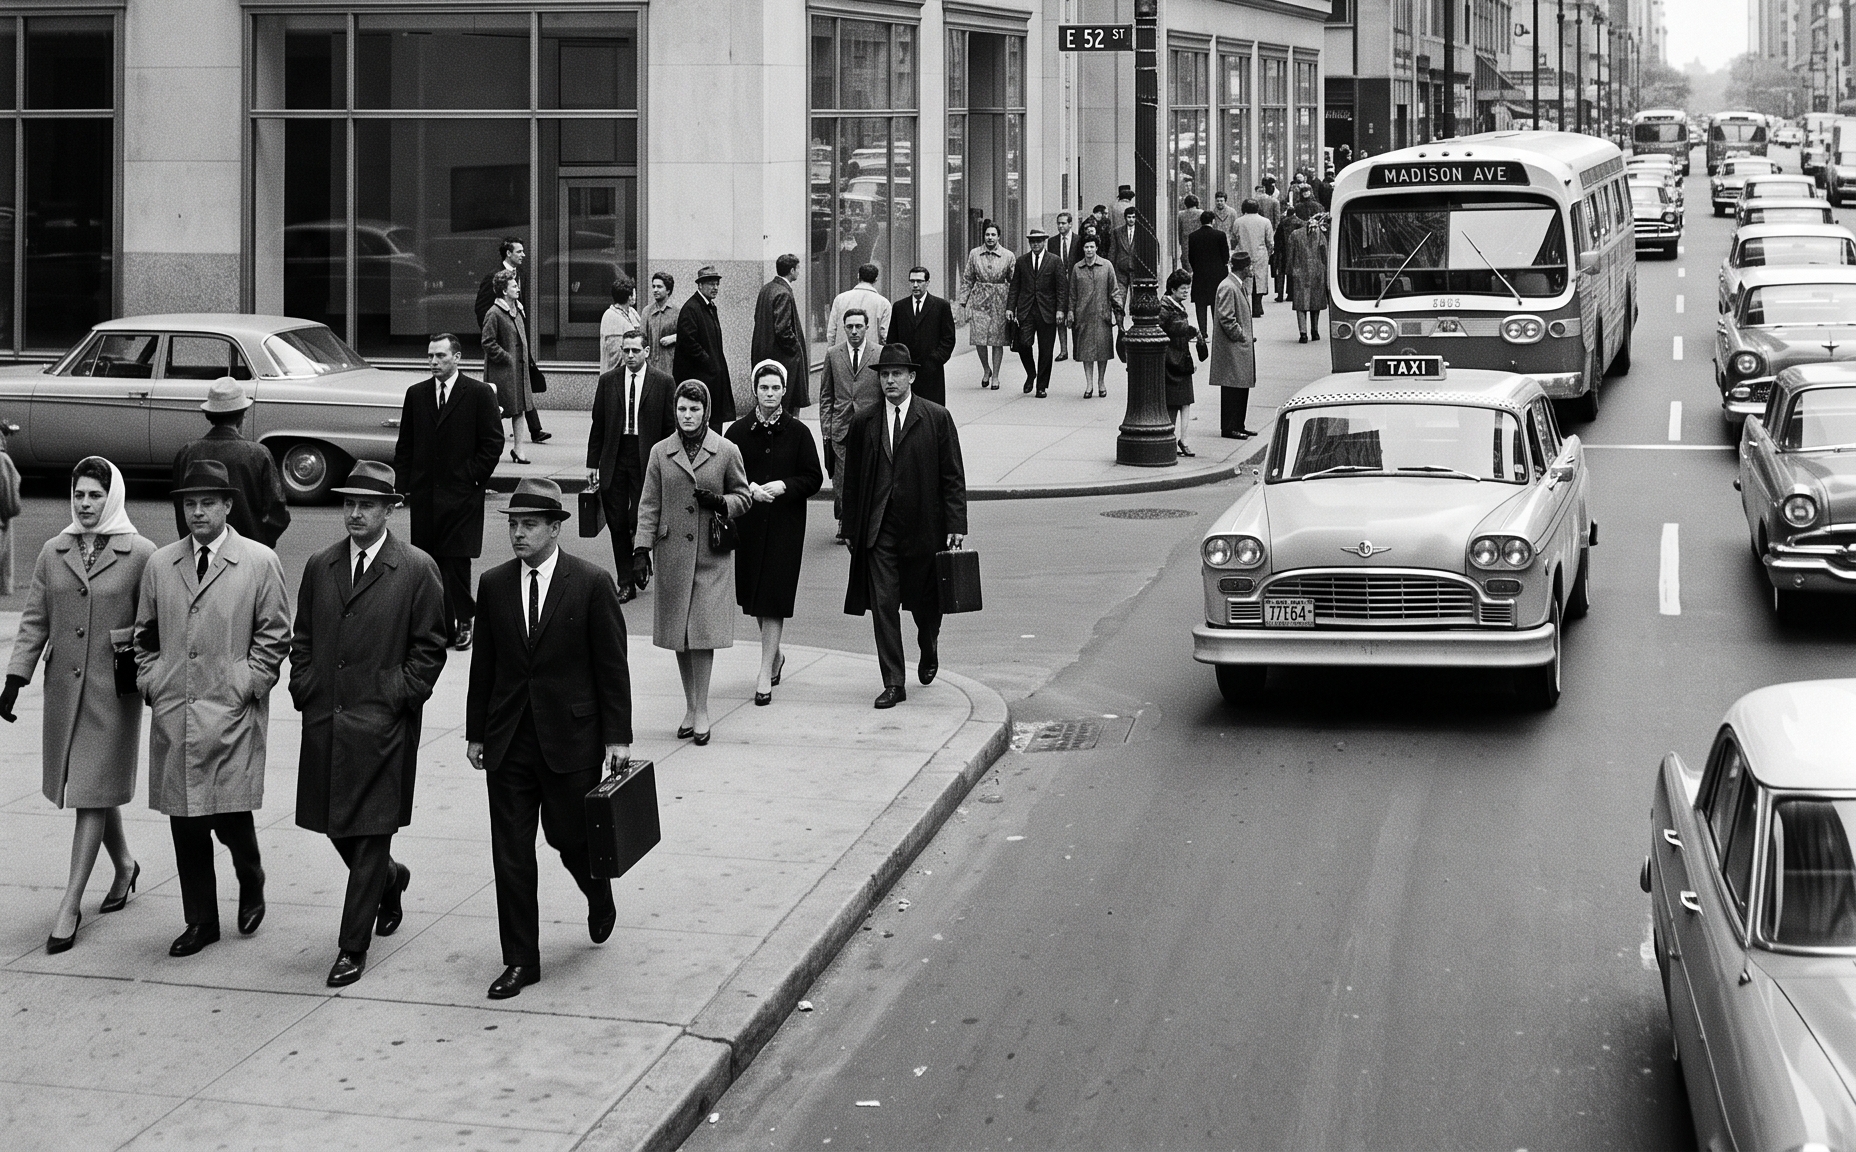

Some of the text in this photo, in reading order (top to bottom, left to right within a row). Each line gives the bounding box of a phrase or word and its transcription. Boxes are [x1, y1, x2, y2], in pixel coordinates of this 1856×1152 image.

[1066, 29, 1125, 48] E 52 ST
[1384, 166, 1507, 183] MADISON AVE
[1387, 360, 1426, 375] TAXI
